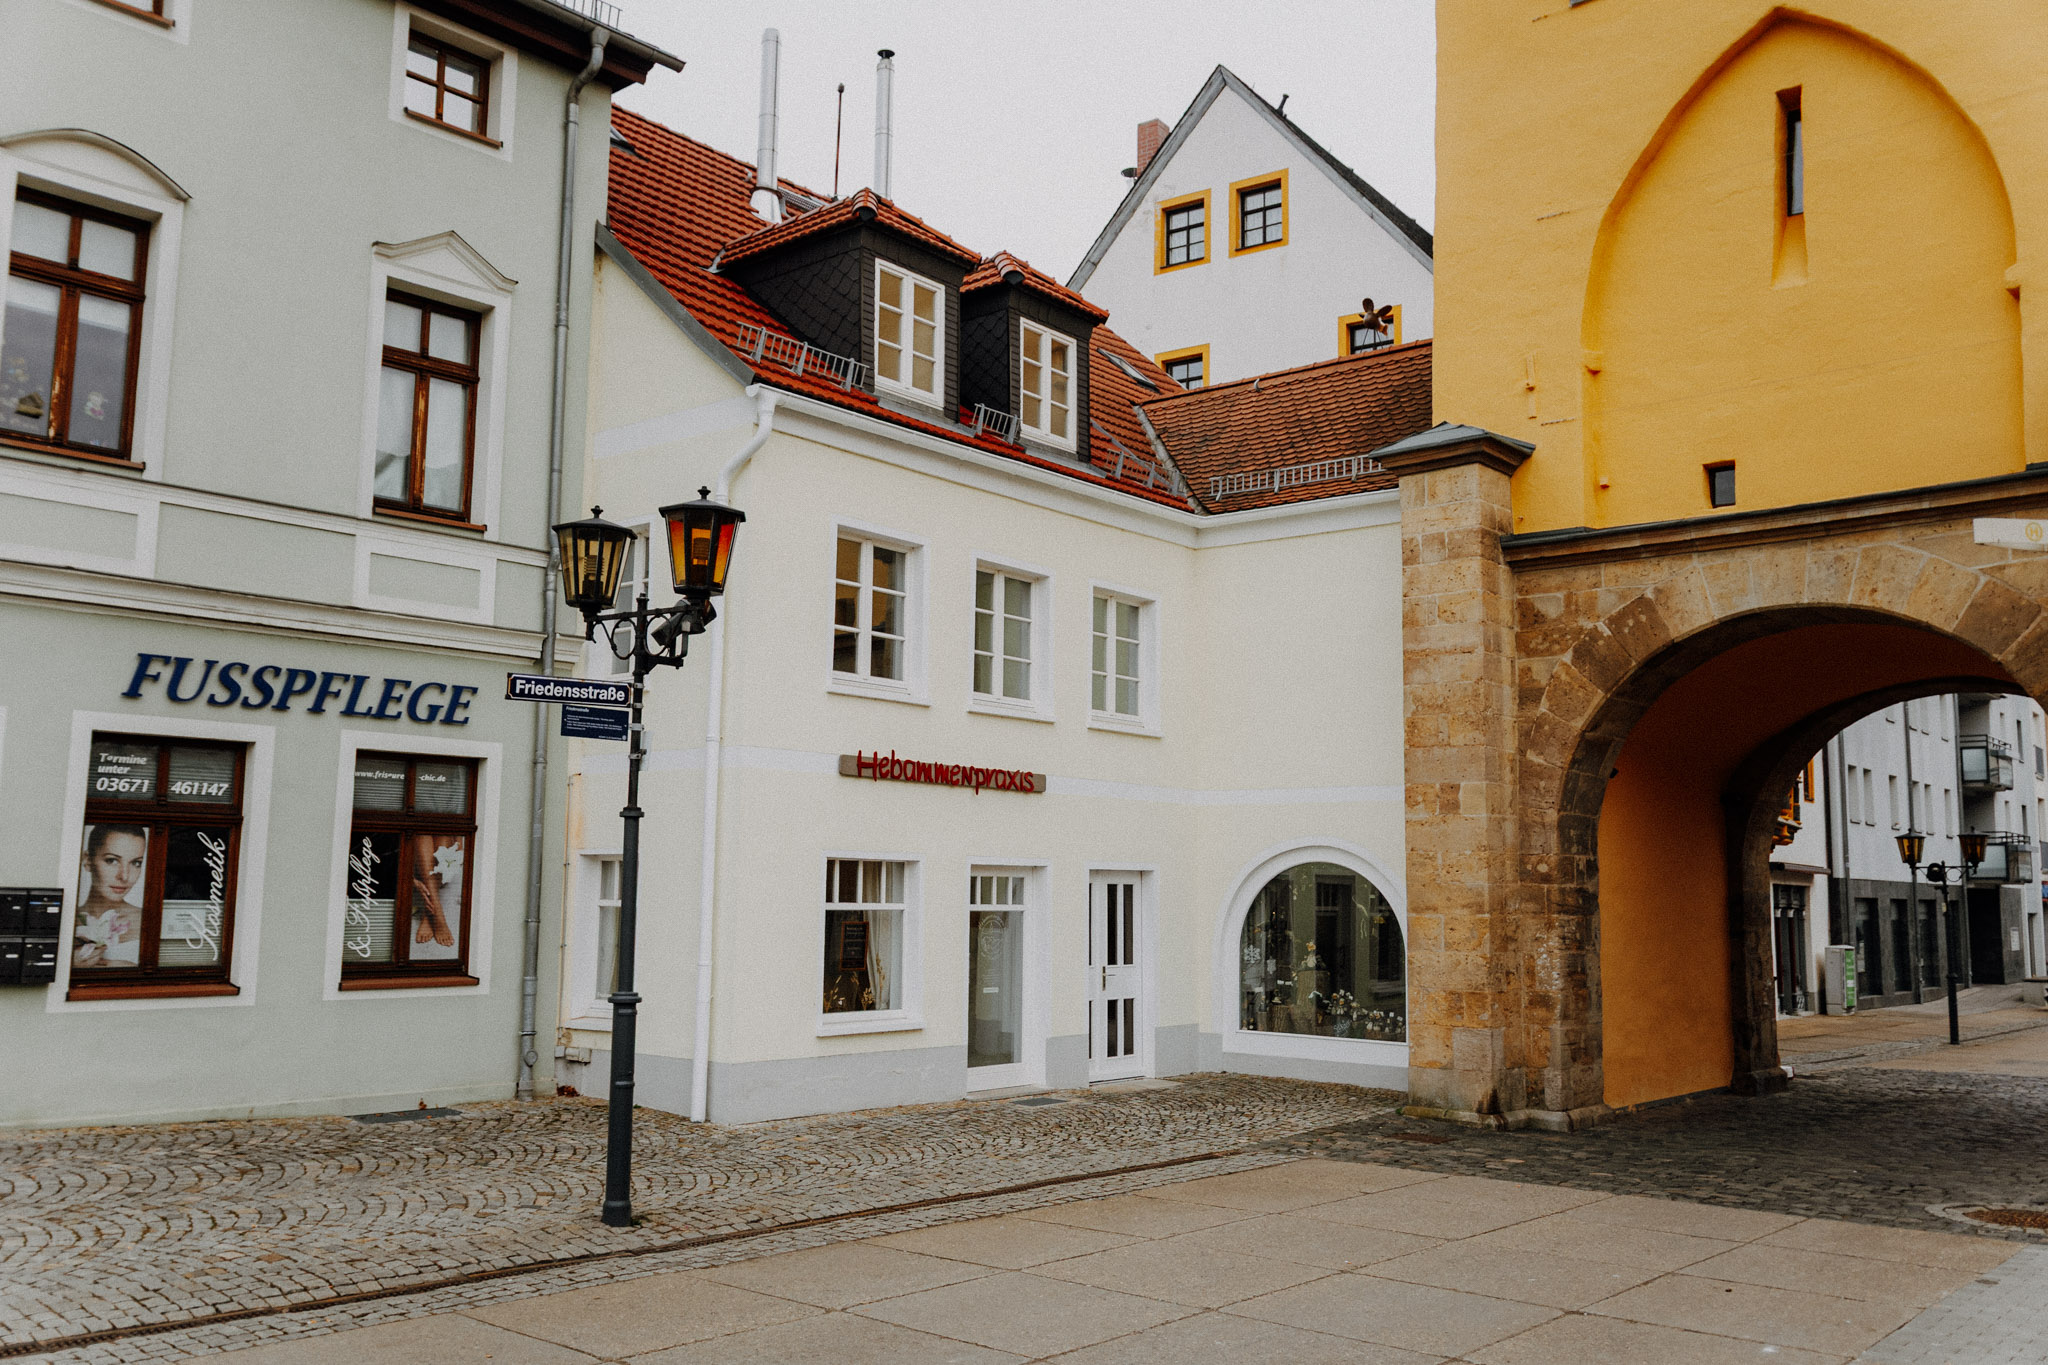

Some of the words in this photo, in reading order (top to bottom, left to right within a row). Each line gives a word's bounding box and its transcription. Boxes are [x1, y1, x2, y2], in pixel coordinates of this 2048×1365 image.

[121, 652, 479, 725] FUSSPFLEGE
[515, 679, 625, 701] Friedensstraße
[97, 765, 131, 774] unter
[99, 752, 148, 765] Termine
[856, 749, 1035, 795] Hebammenpraxis
[96, 777, 150, 793] 03671
[170, 781, 229, 796] 461147
[186, 831, 226, 961] Kosmetik
[346, 836, 381, 932] Fußpflege
[347, 934, 371, 958] &
